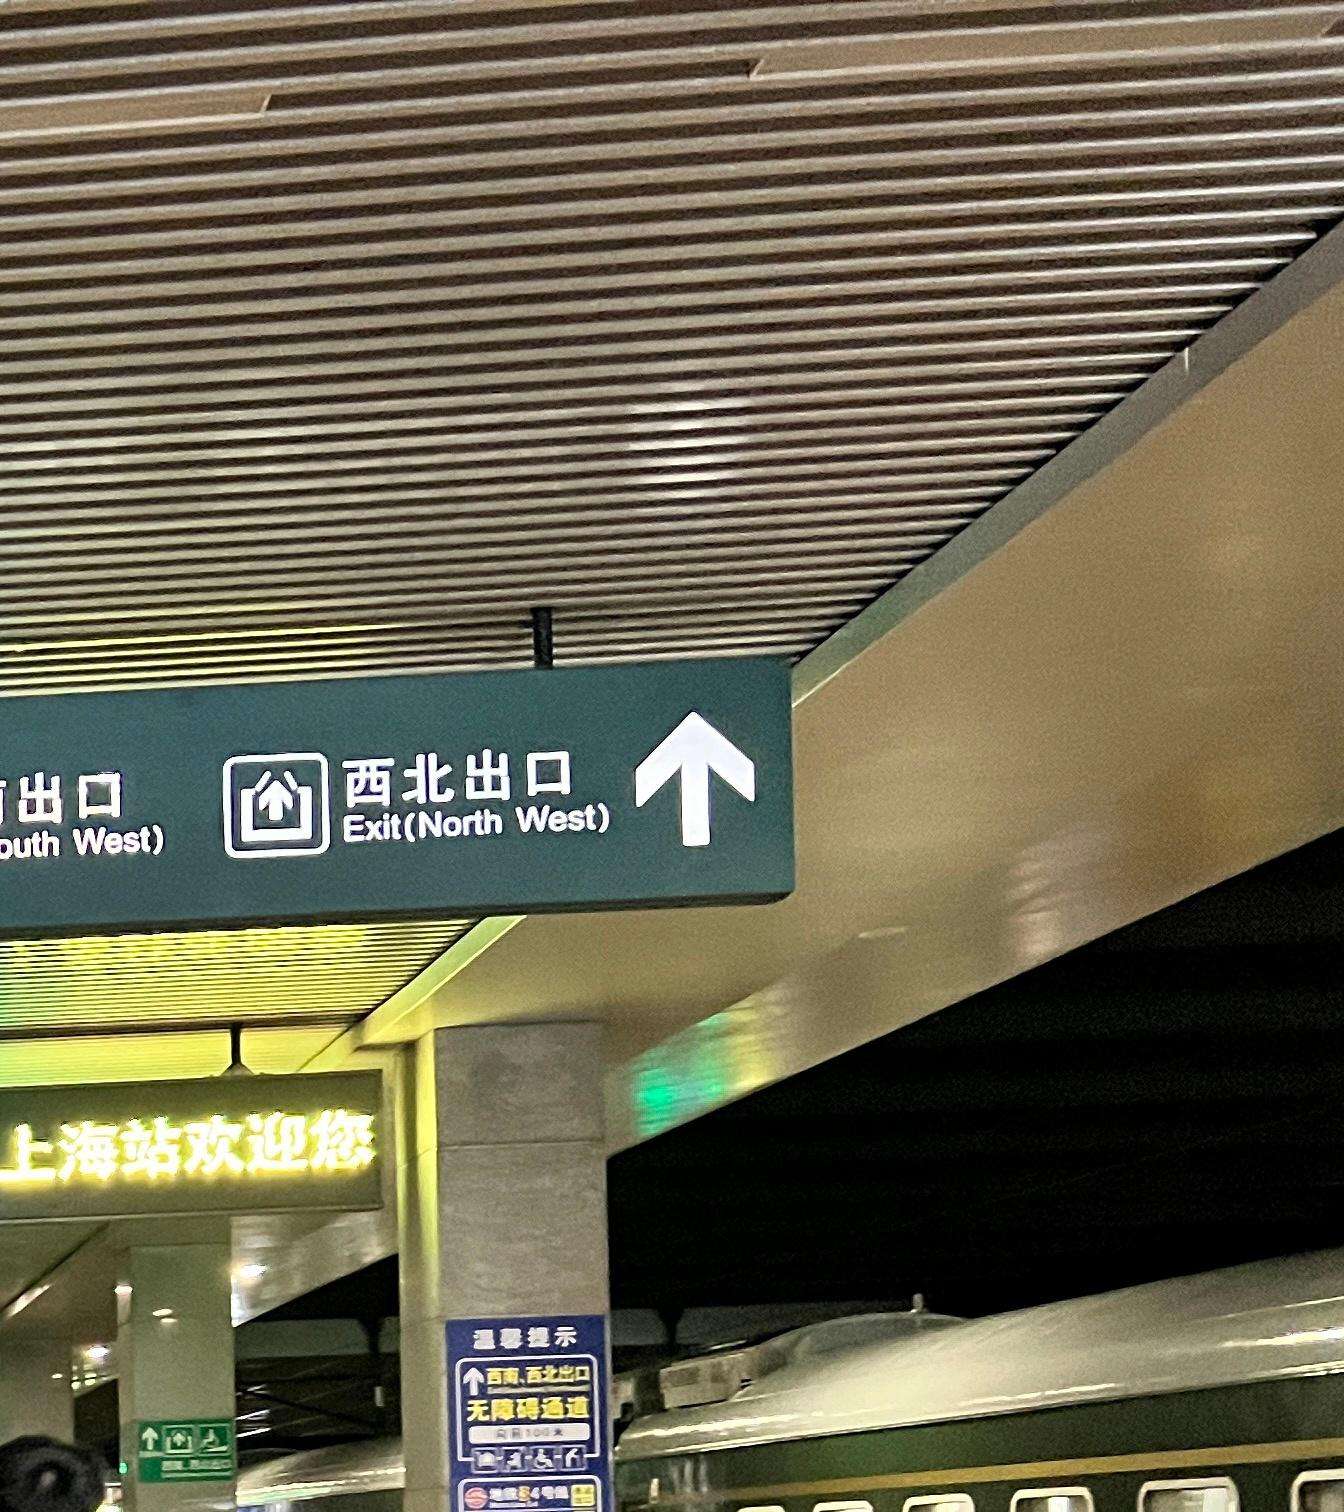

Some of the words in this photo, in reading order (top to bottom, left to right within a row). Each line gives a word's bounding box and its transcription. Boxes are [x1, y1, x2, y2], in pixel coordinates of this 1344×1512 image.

[342, 749, 571, 808] 西北出口
[72, 824, 164, 856] West)
[343, 808, 503, 842] Exit(North
[515, 803, 610, 833] West)
